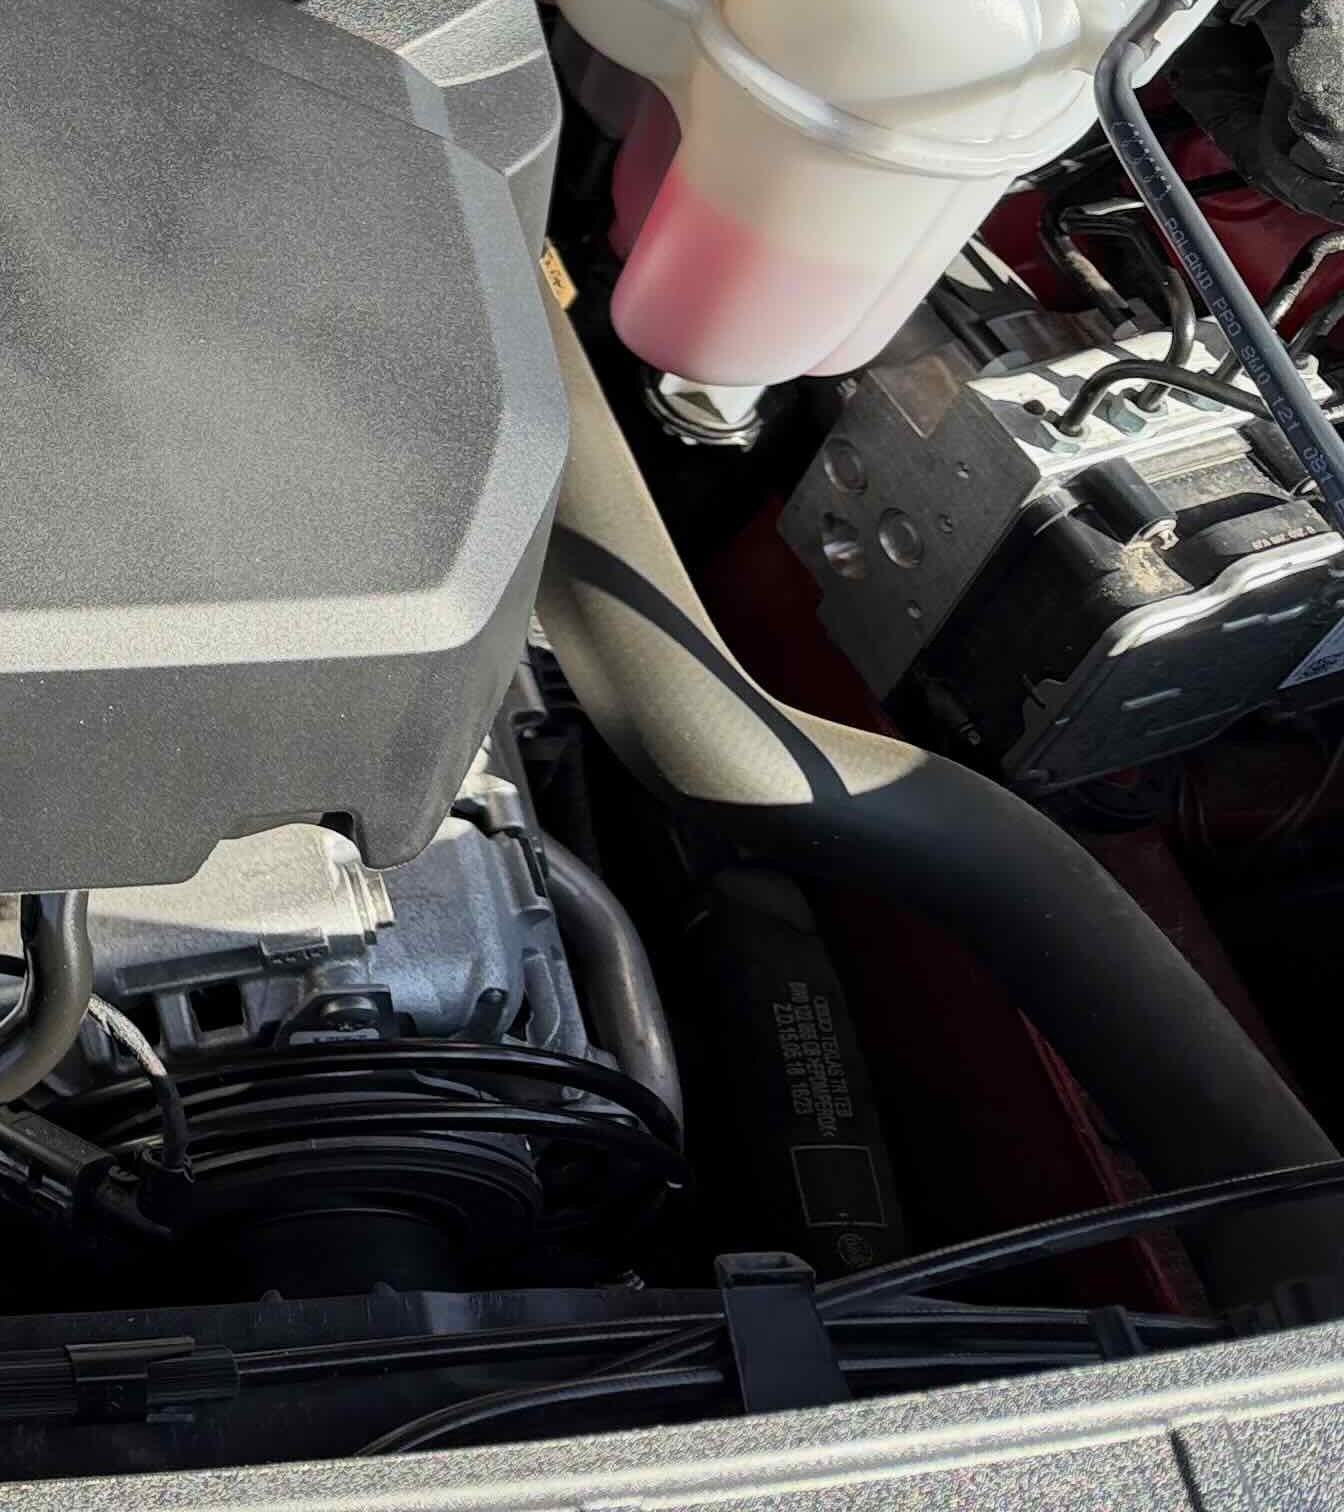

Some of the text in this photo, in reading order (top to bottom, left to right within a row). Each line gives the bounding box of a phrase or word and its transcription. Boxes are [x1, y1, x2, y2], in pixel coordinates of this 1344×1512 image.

[1163, 216, 1216, 291] POLAND
[1240, 343, 1272, 386] 8W0
[1272, 394, 1302, 431] 121
